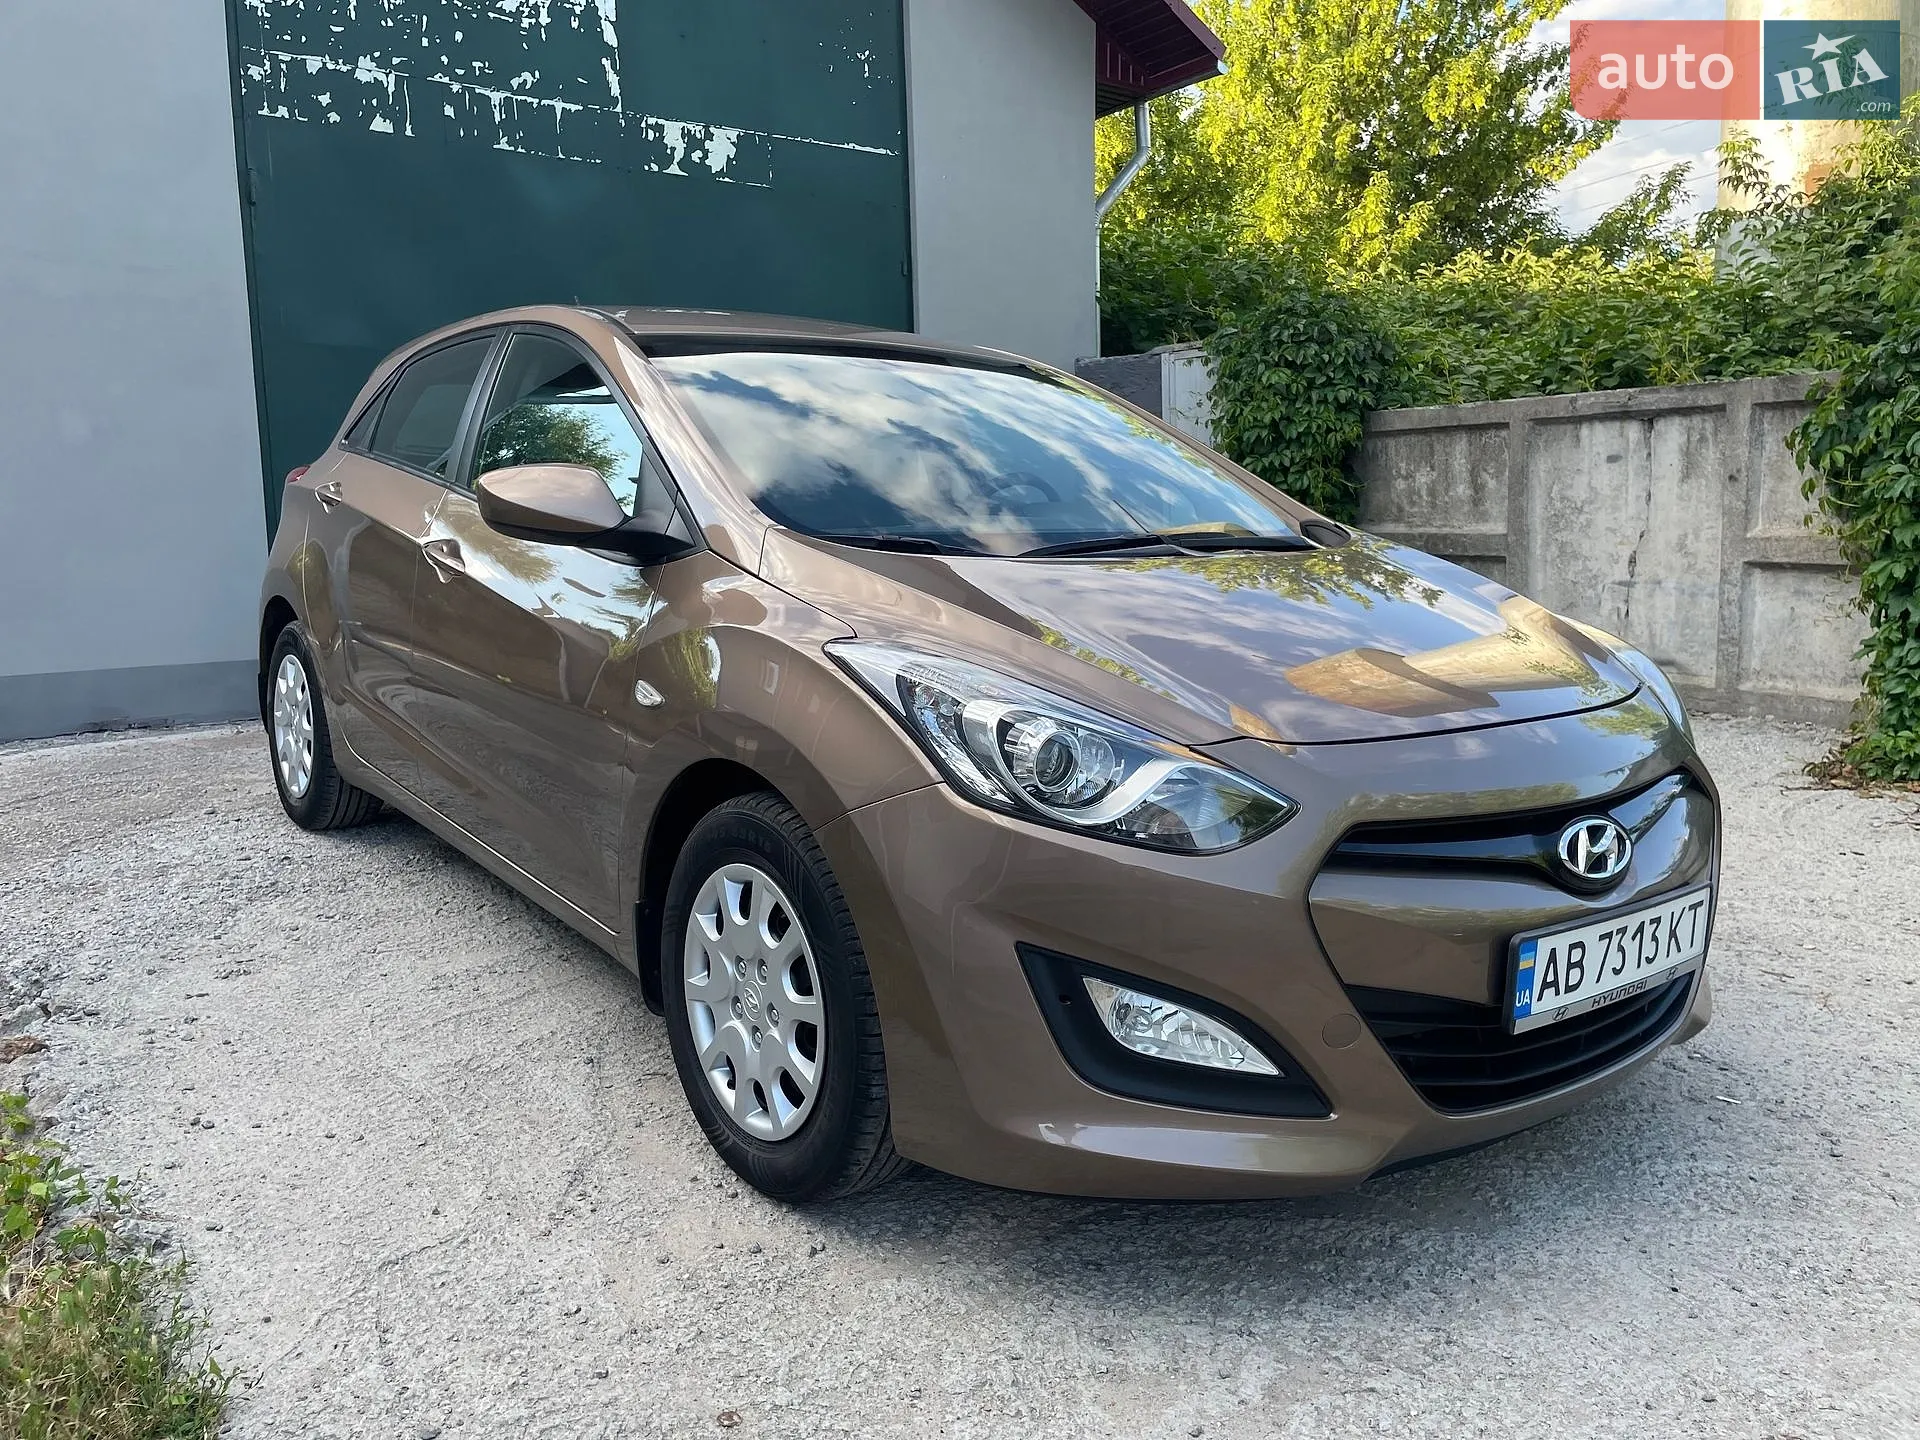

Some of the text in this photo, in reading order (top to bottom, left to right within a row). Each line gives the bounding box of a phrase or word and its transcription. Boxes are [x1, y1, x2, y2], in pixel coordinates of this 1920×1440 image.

[1537, 900, 1704, 1002] AB 7313 KT
[1515, 991, 1530, 1007] UA
[1591, 979, 1648, 1008] HYUNDAI
